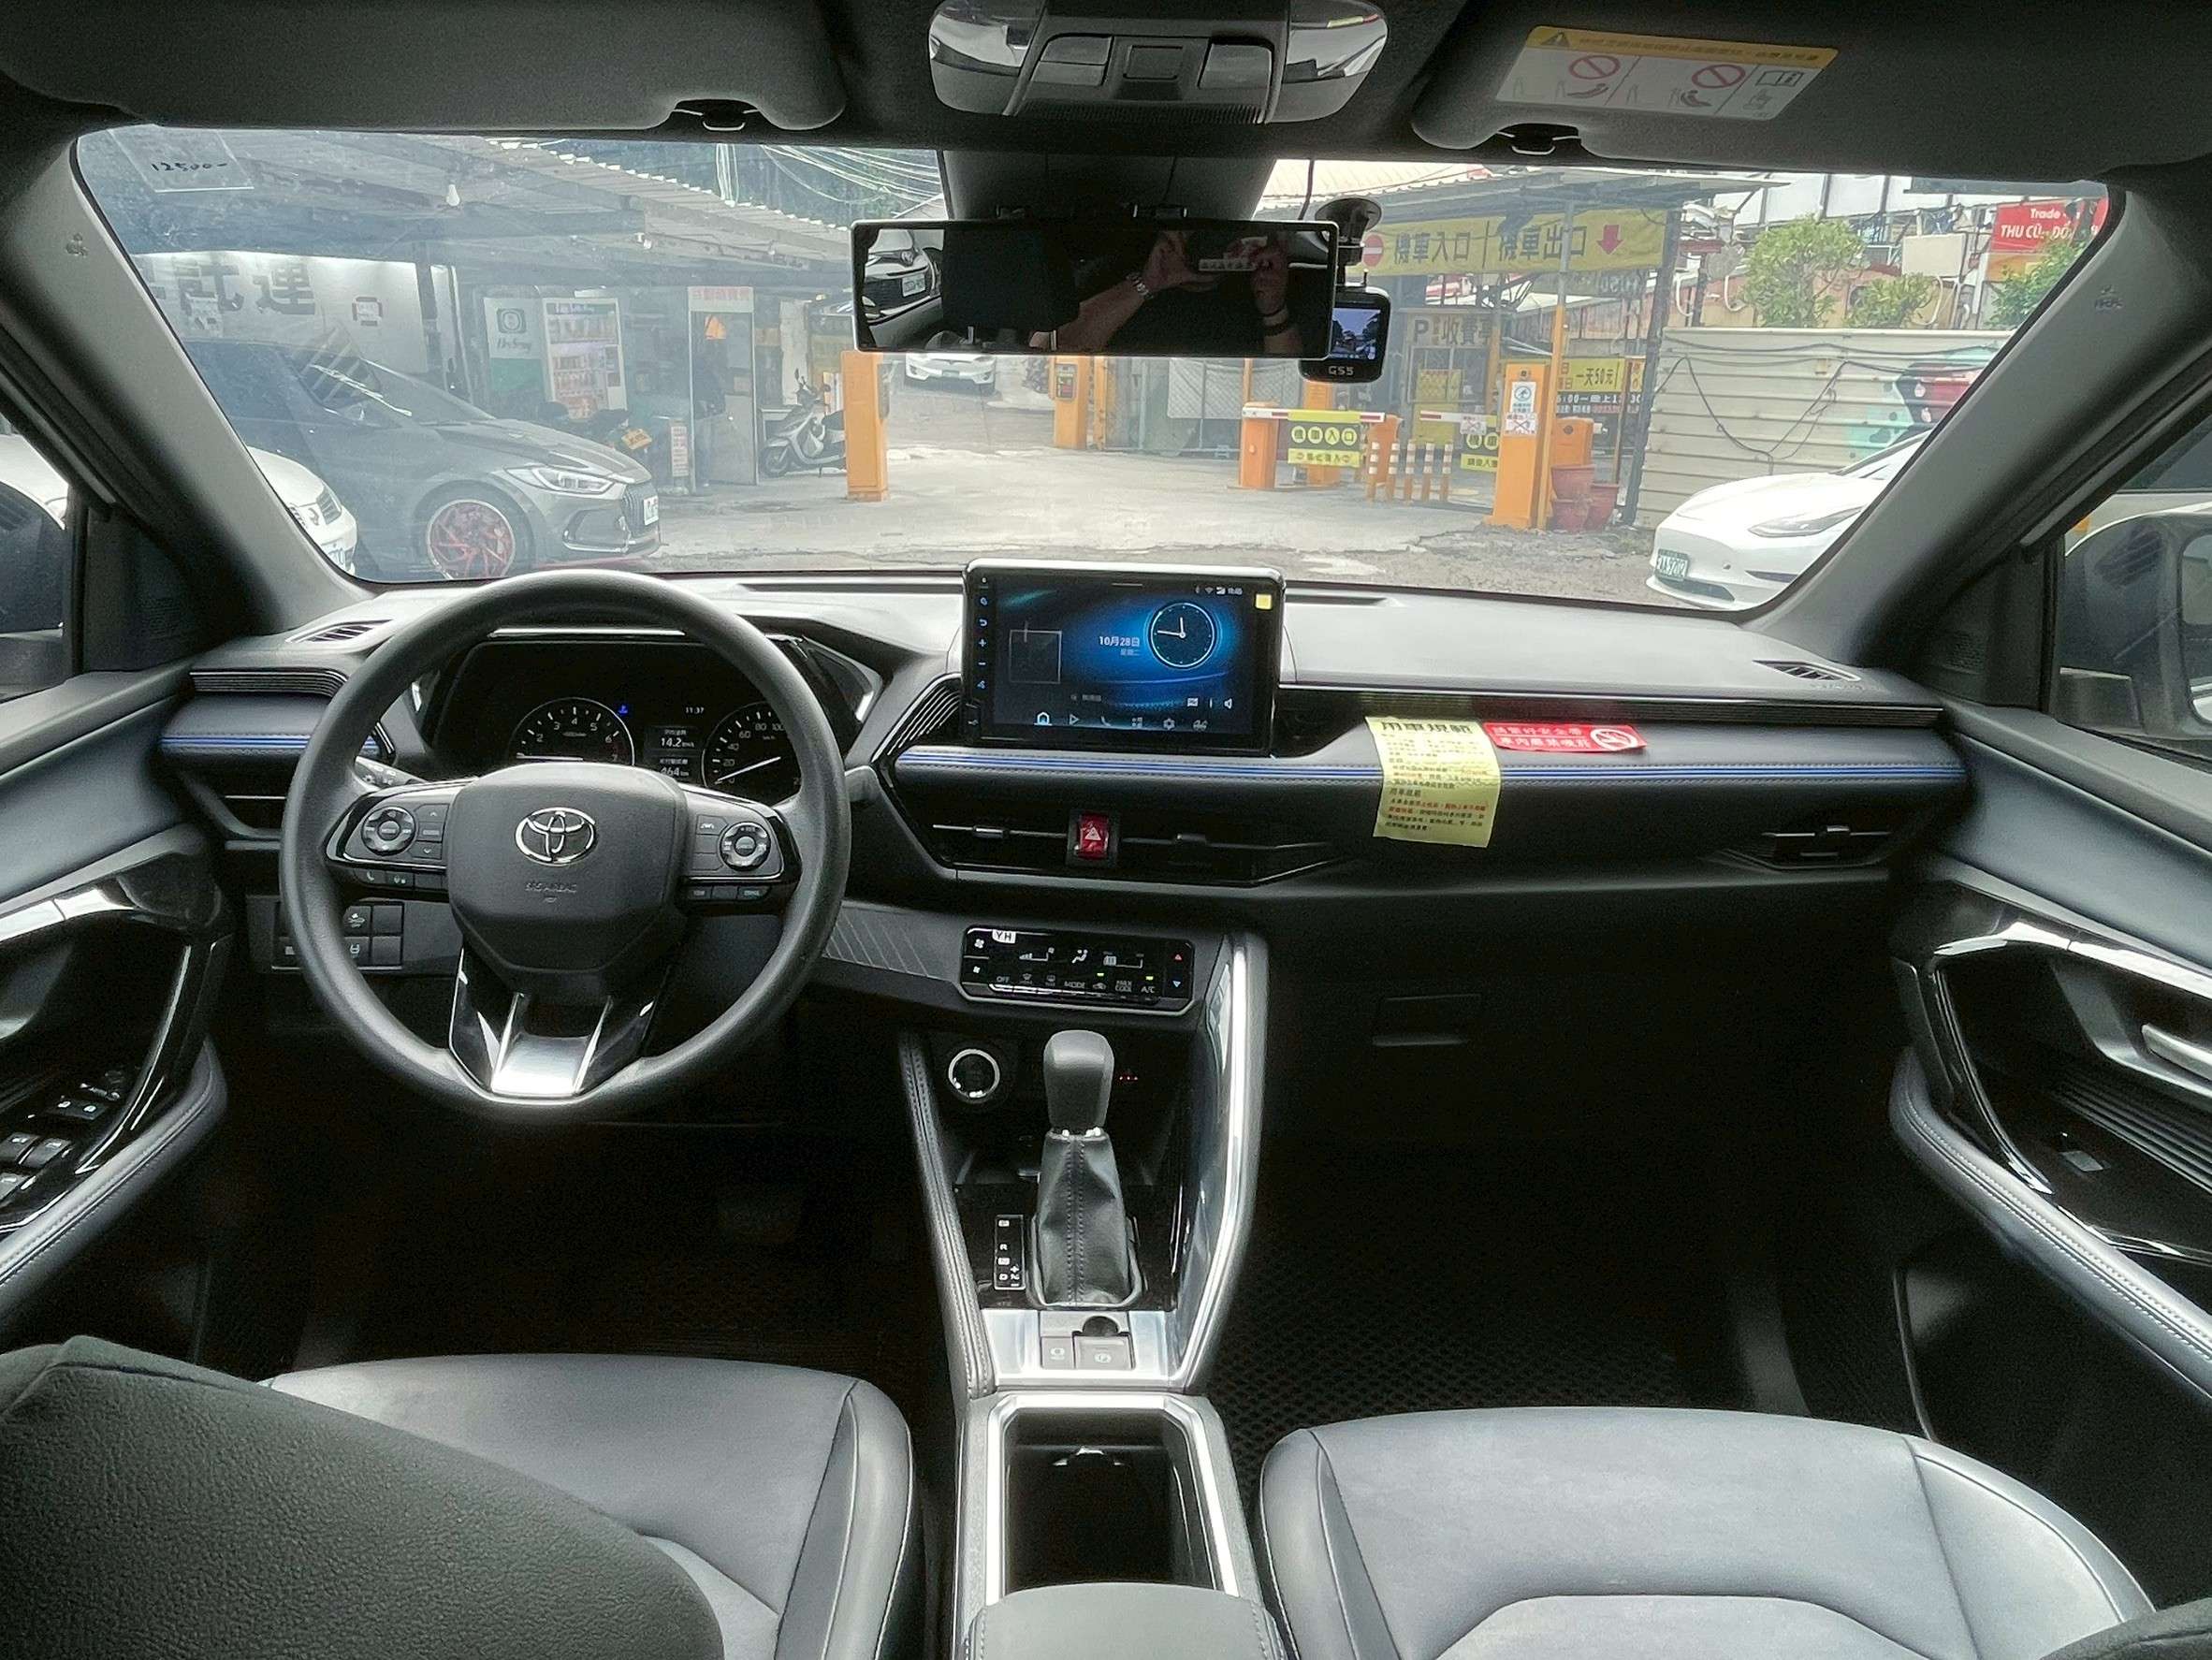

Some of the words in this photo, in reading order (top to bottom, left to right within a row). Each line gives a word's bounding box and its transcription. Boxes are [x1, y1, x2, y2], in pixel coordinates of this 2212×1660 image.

[2030, 208, 2061, 219] Trade
[2001, 225, 2024, 239] THU
[1394, 231, 1470, 264] 機車入口
[1329, 365, 1354, 376] GS5
[1099, 636, 1141, 647] 10月28日
[554, 721, 560, 730] 3
[589, 722, 598, 731] 5
[536, 734, 544, 742] 2
[604, 735, 612, 743] 6
[662, 737, 682, 748] 14.2
[995, 931, 1015, 943] YH
[1064, 981, 1085, 989] MODE
[1141, 985, 1156, 994] A/C
